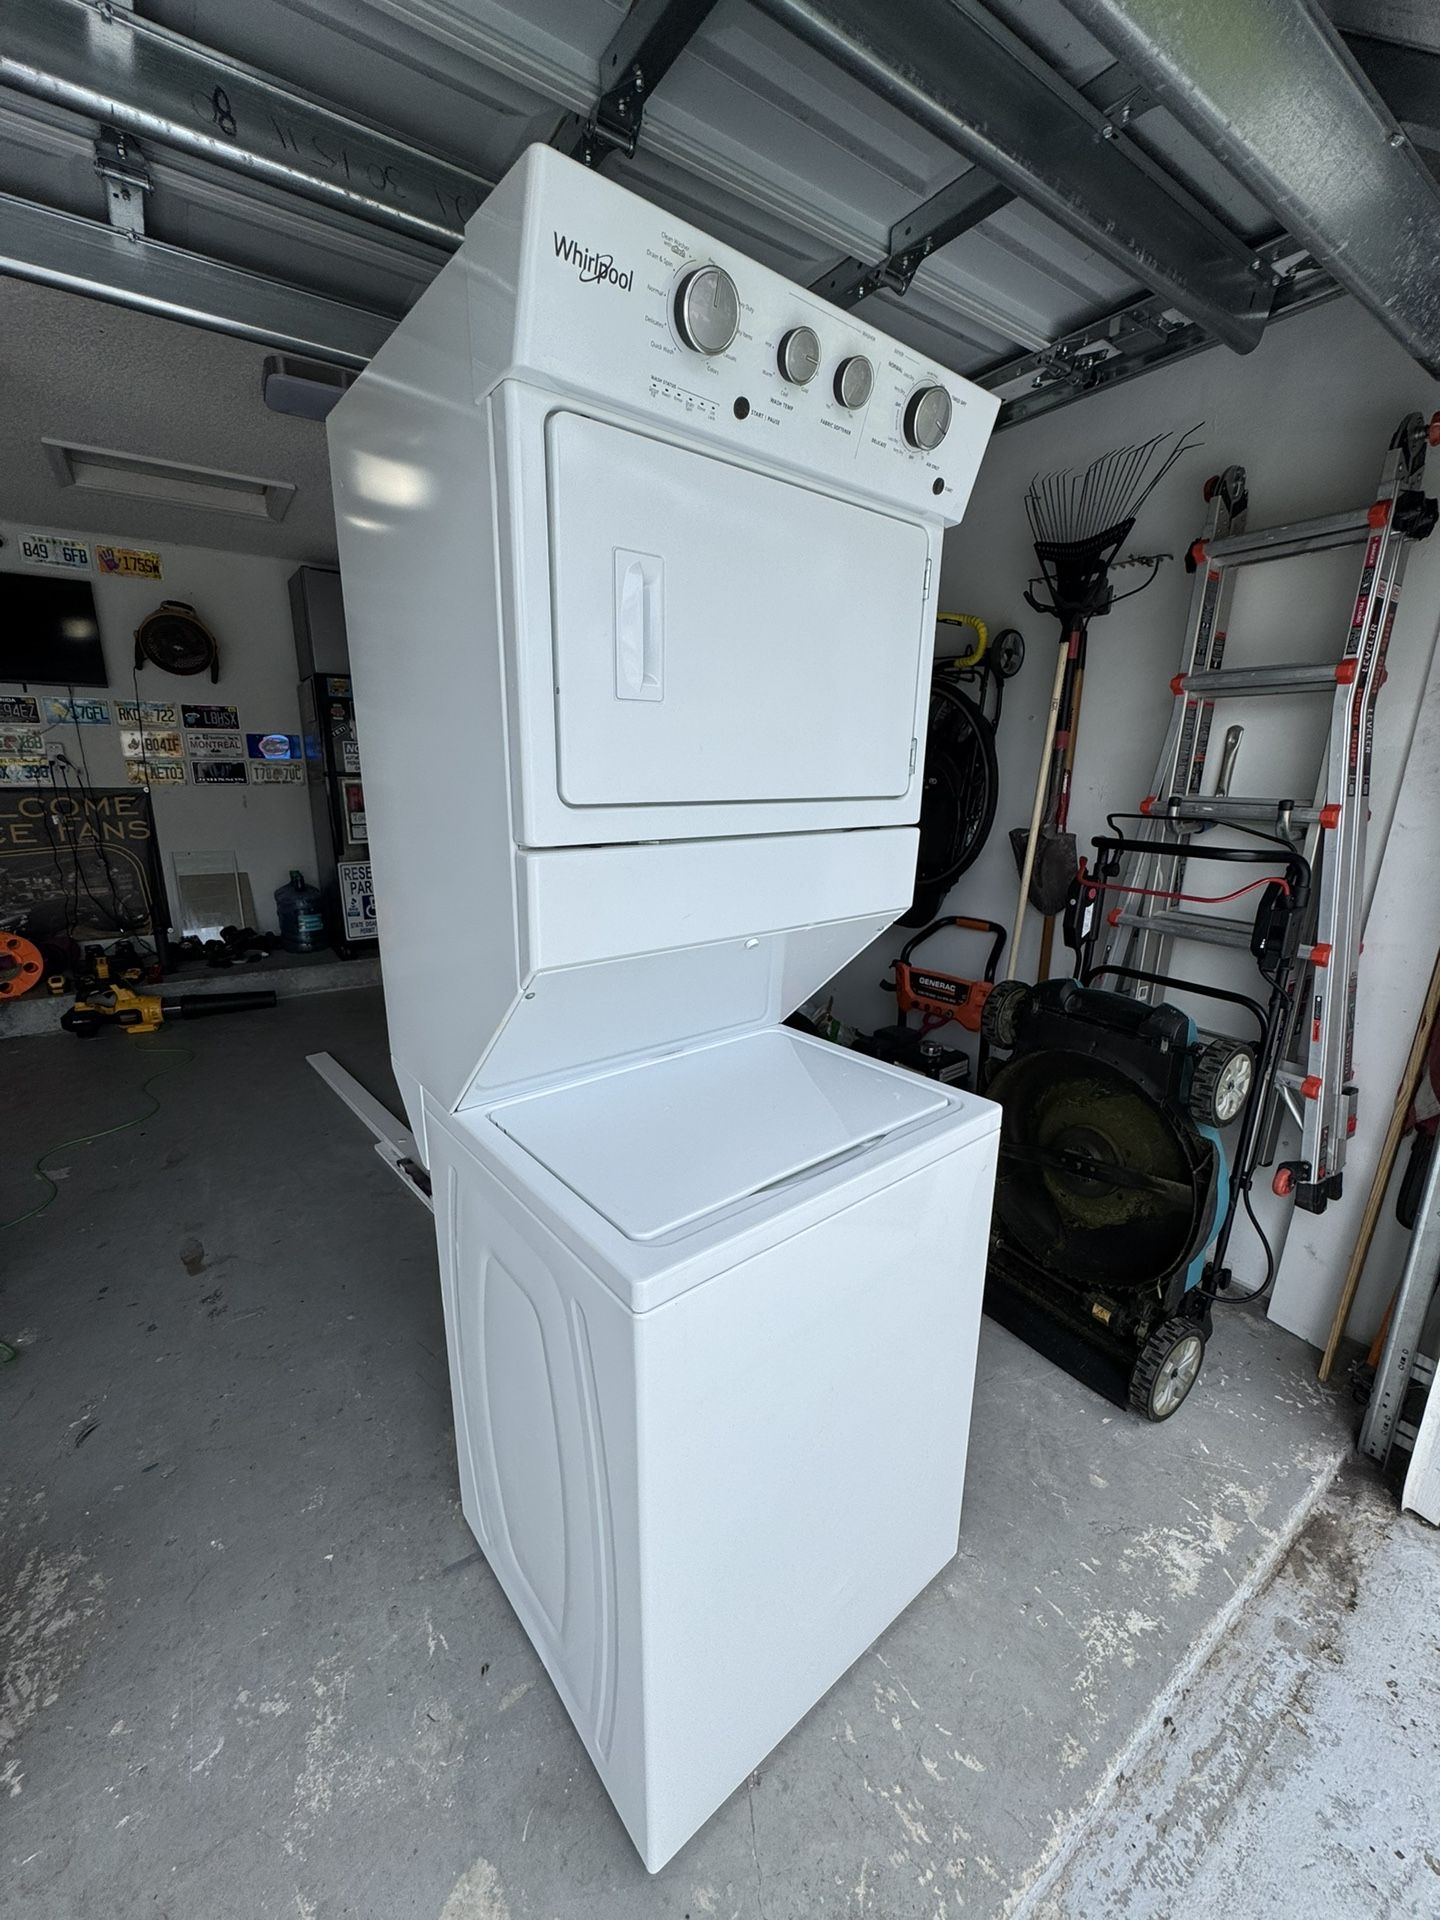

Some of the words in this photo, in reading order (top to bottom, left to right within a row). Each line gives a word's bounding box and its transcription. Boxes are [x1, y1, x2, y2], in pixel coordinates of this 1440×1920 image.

[554, 231, 634, 293] Whirlpool
[751, 409, 764, 419] START
[767, 415, 781, 427] PAUSE
[1361, 622, 1379, 674] LEVELER
[153, 708, 175, 722] 722
[1364, 708, 1374, 754] LEVELER
[190, 740, 241, 750] MONTREAL
[58, 819, 152, 843] FANS
[919, 976, 957, 992] GENERAC
